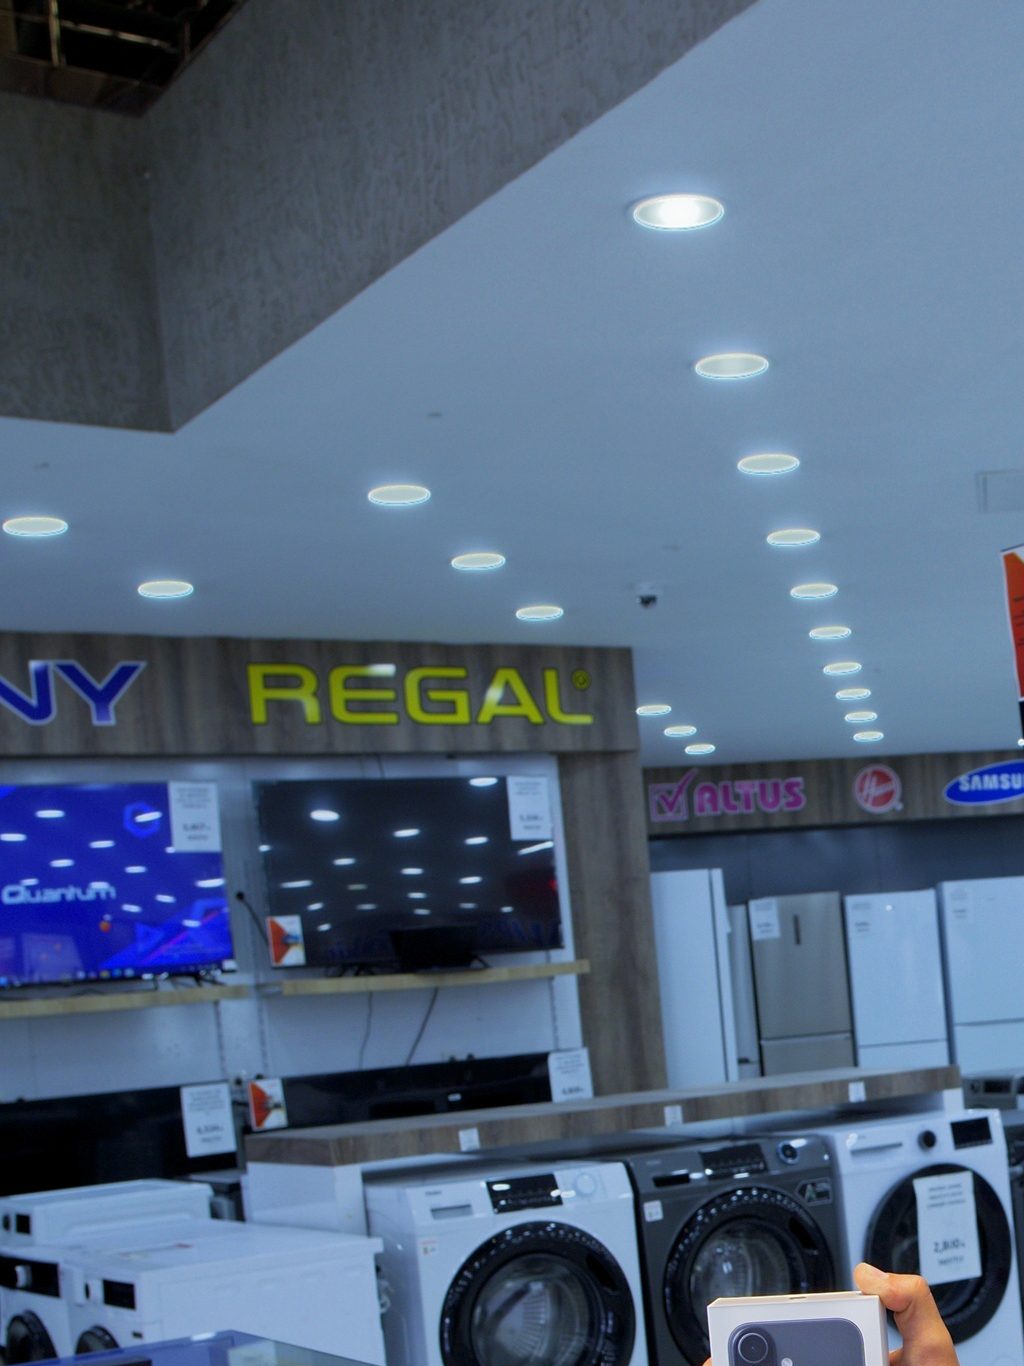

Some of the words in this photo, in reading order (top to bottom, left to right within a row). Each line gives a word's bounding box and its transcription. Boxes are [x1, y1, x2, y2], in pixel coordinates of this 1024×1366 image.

[247, 663, 594, 725] REGAL
[694, 777, 807, 814] ALTUS
[1, 884, 117, 904] Quantum
